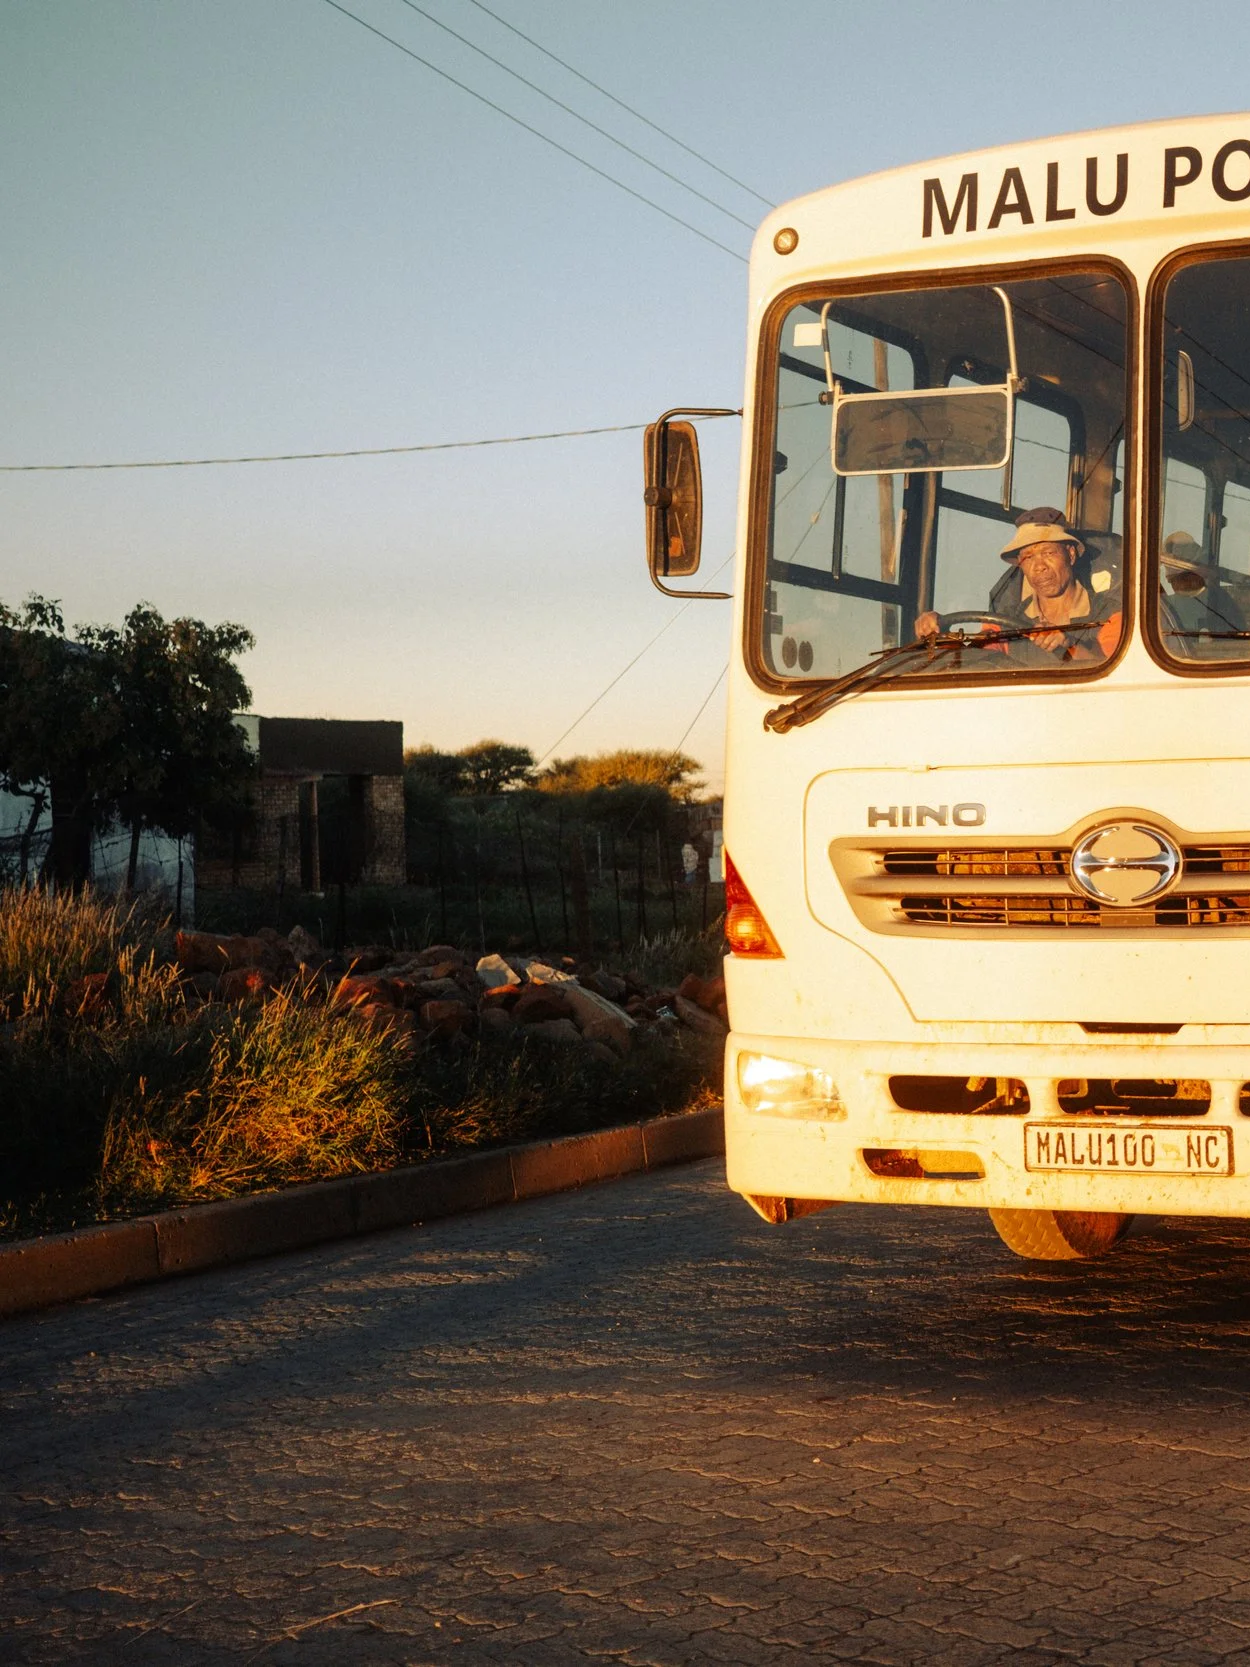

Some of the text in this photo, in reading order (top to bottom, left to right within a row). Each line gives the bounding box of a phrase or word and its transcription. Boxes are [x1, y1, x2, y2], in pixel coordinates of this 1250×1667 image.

[922, 153, 1129, 238] MALU
[868, 802, 987, 828] HINO
[1036, 1131, 1220, 1168] MALU100 NC
